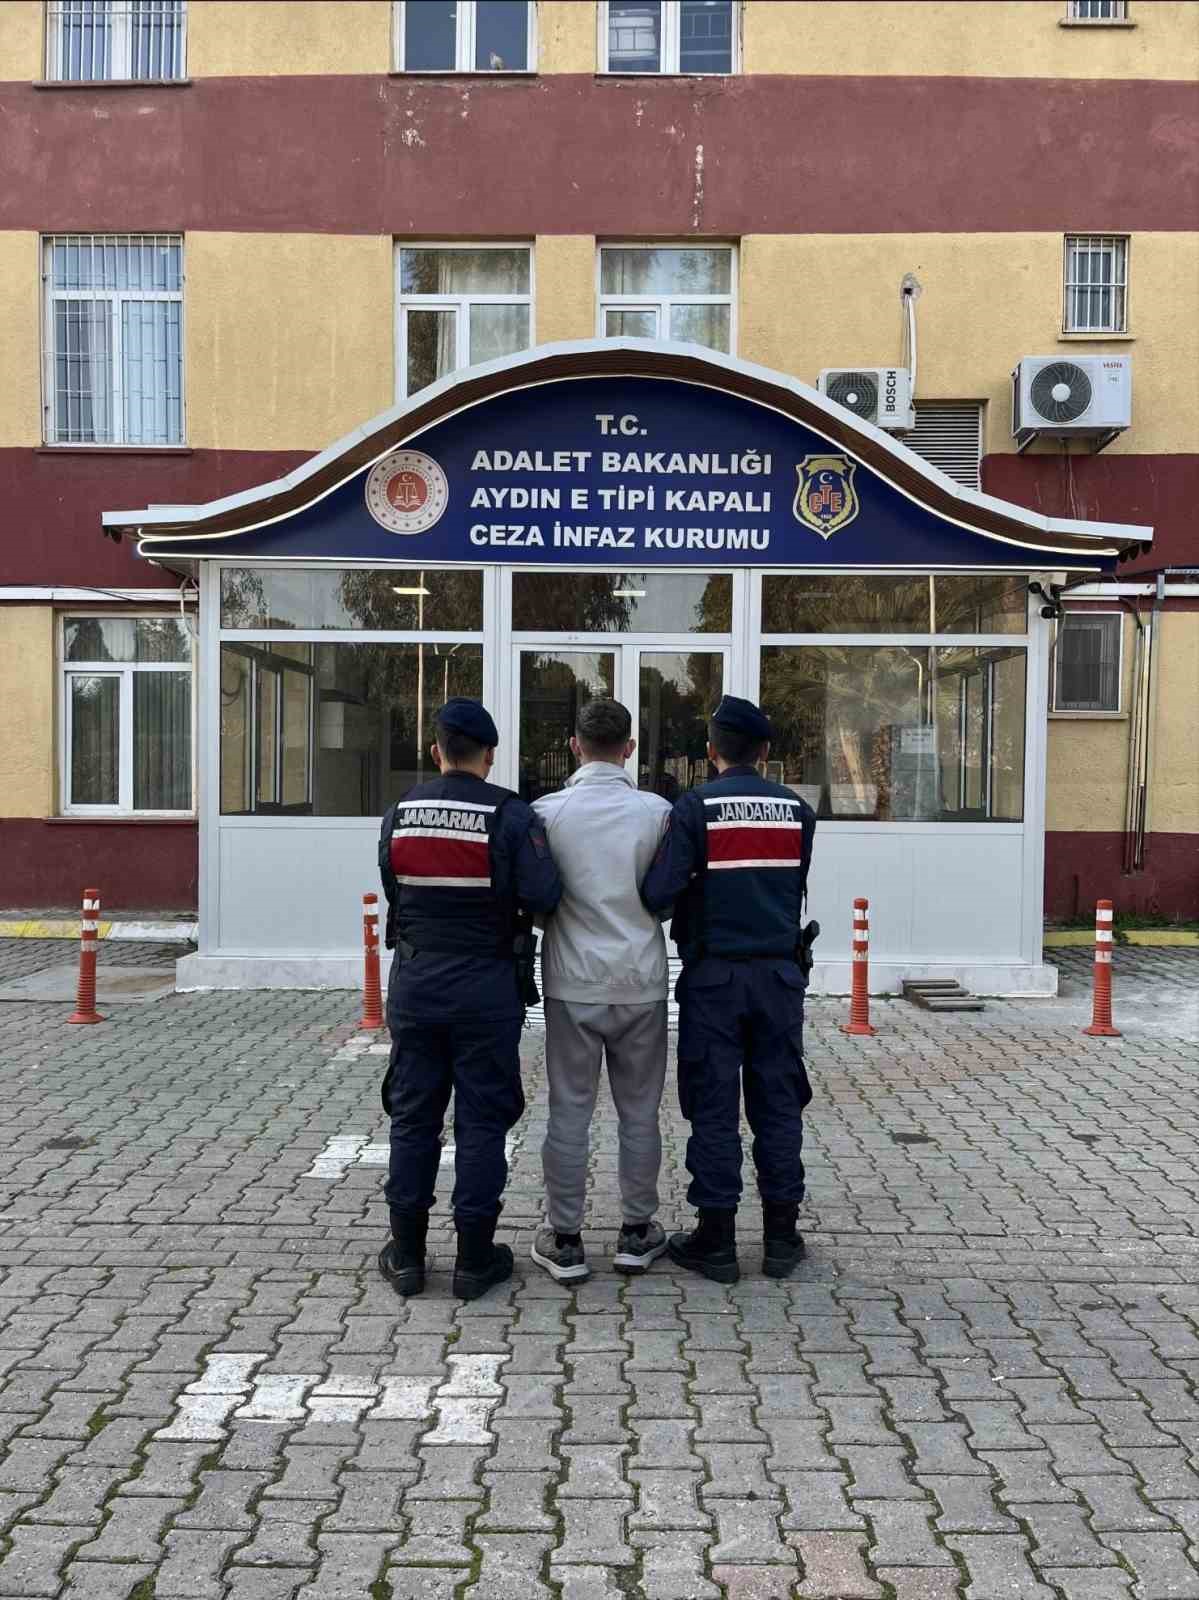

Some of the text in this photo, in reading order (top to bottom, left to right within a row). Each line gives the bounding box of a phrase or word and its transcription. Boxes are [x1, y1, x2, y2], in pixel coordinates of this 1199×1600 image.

[885, 370, 897, 412] BOSCH
[595, 414, 648, 436] T.C.
[470, 449, 772, 475] ADALET BAKANLIĞI
[470, 484, 771, 513] AYDIN E TİPİ KAPALI
[469, 521, 770, 550] CEZA İNFAZ KURUMU
[400, 808, 487, 832] JANDARMA
[717, 801, 794, 822] JANDARMA
